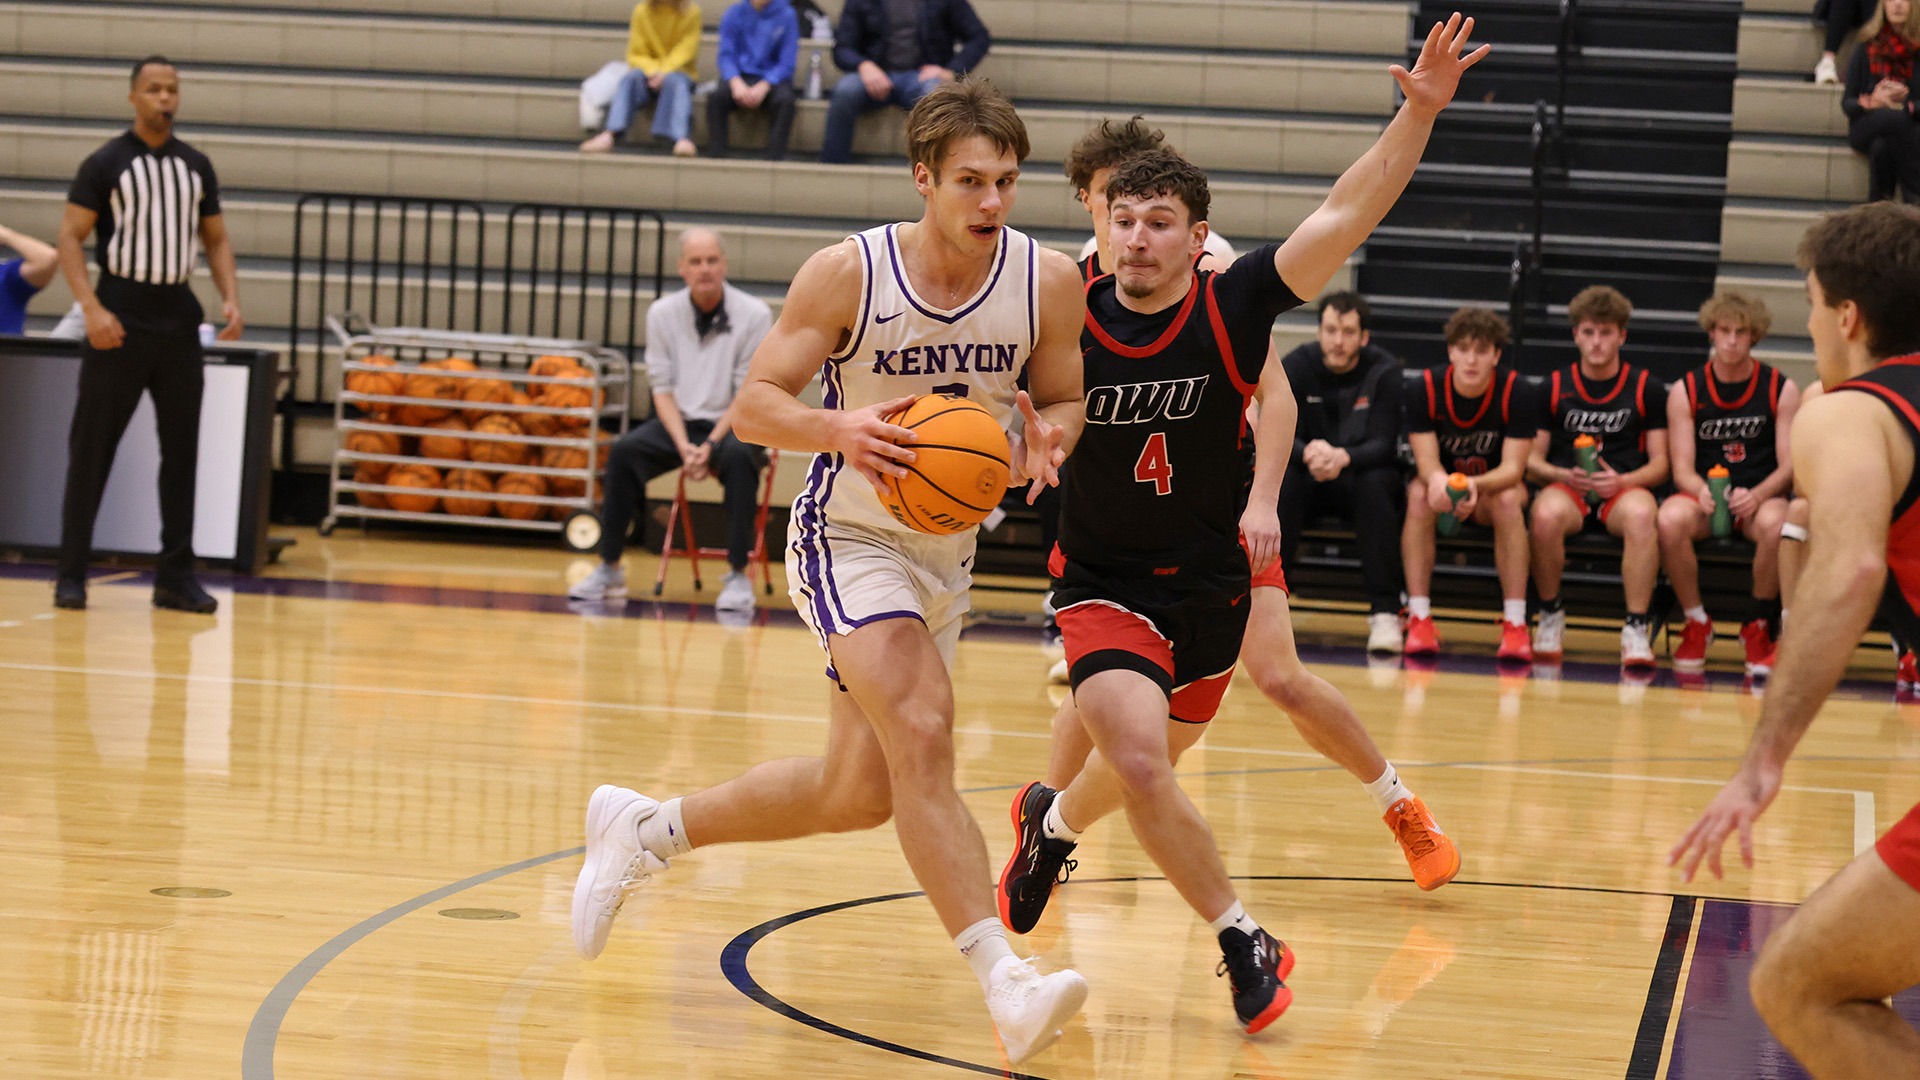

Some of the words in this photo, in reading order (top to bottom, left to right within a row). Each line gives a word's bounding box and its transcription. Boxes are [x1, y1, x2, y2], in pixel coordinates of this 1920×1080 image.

[872, 343, 1018, 376] KENYON
[1085, 374, 1210, 425] OWU
[1564, 408, 1632, 433] OWU
[1699, 415, 1767, 440] OWU
[1134, 432, 1173, 496] 4
[1722, 442, 1747, 464] 3
